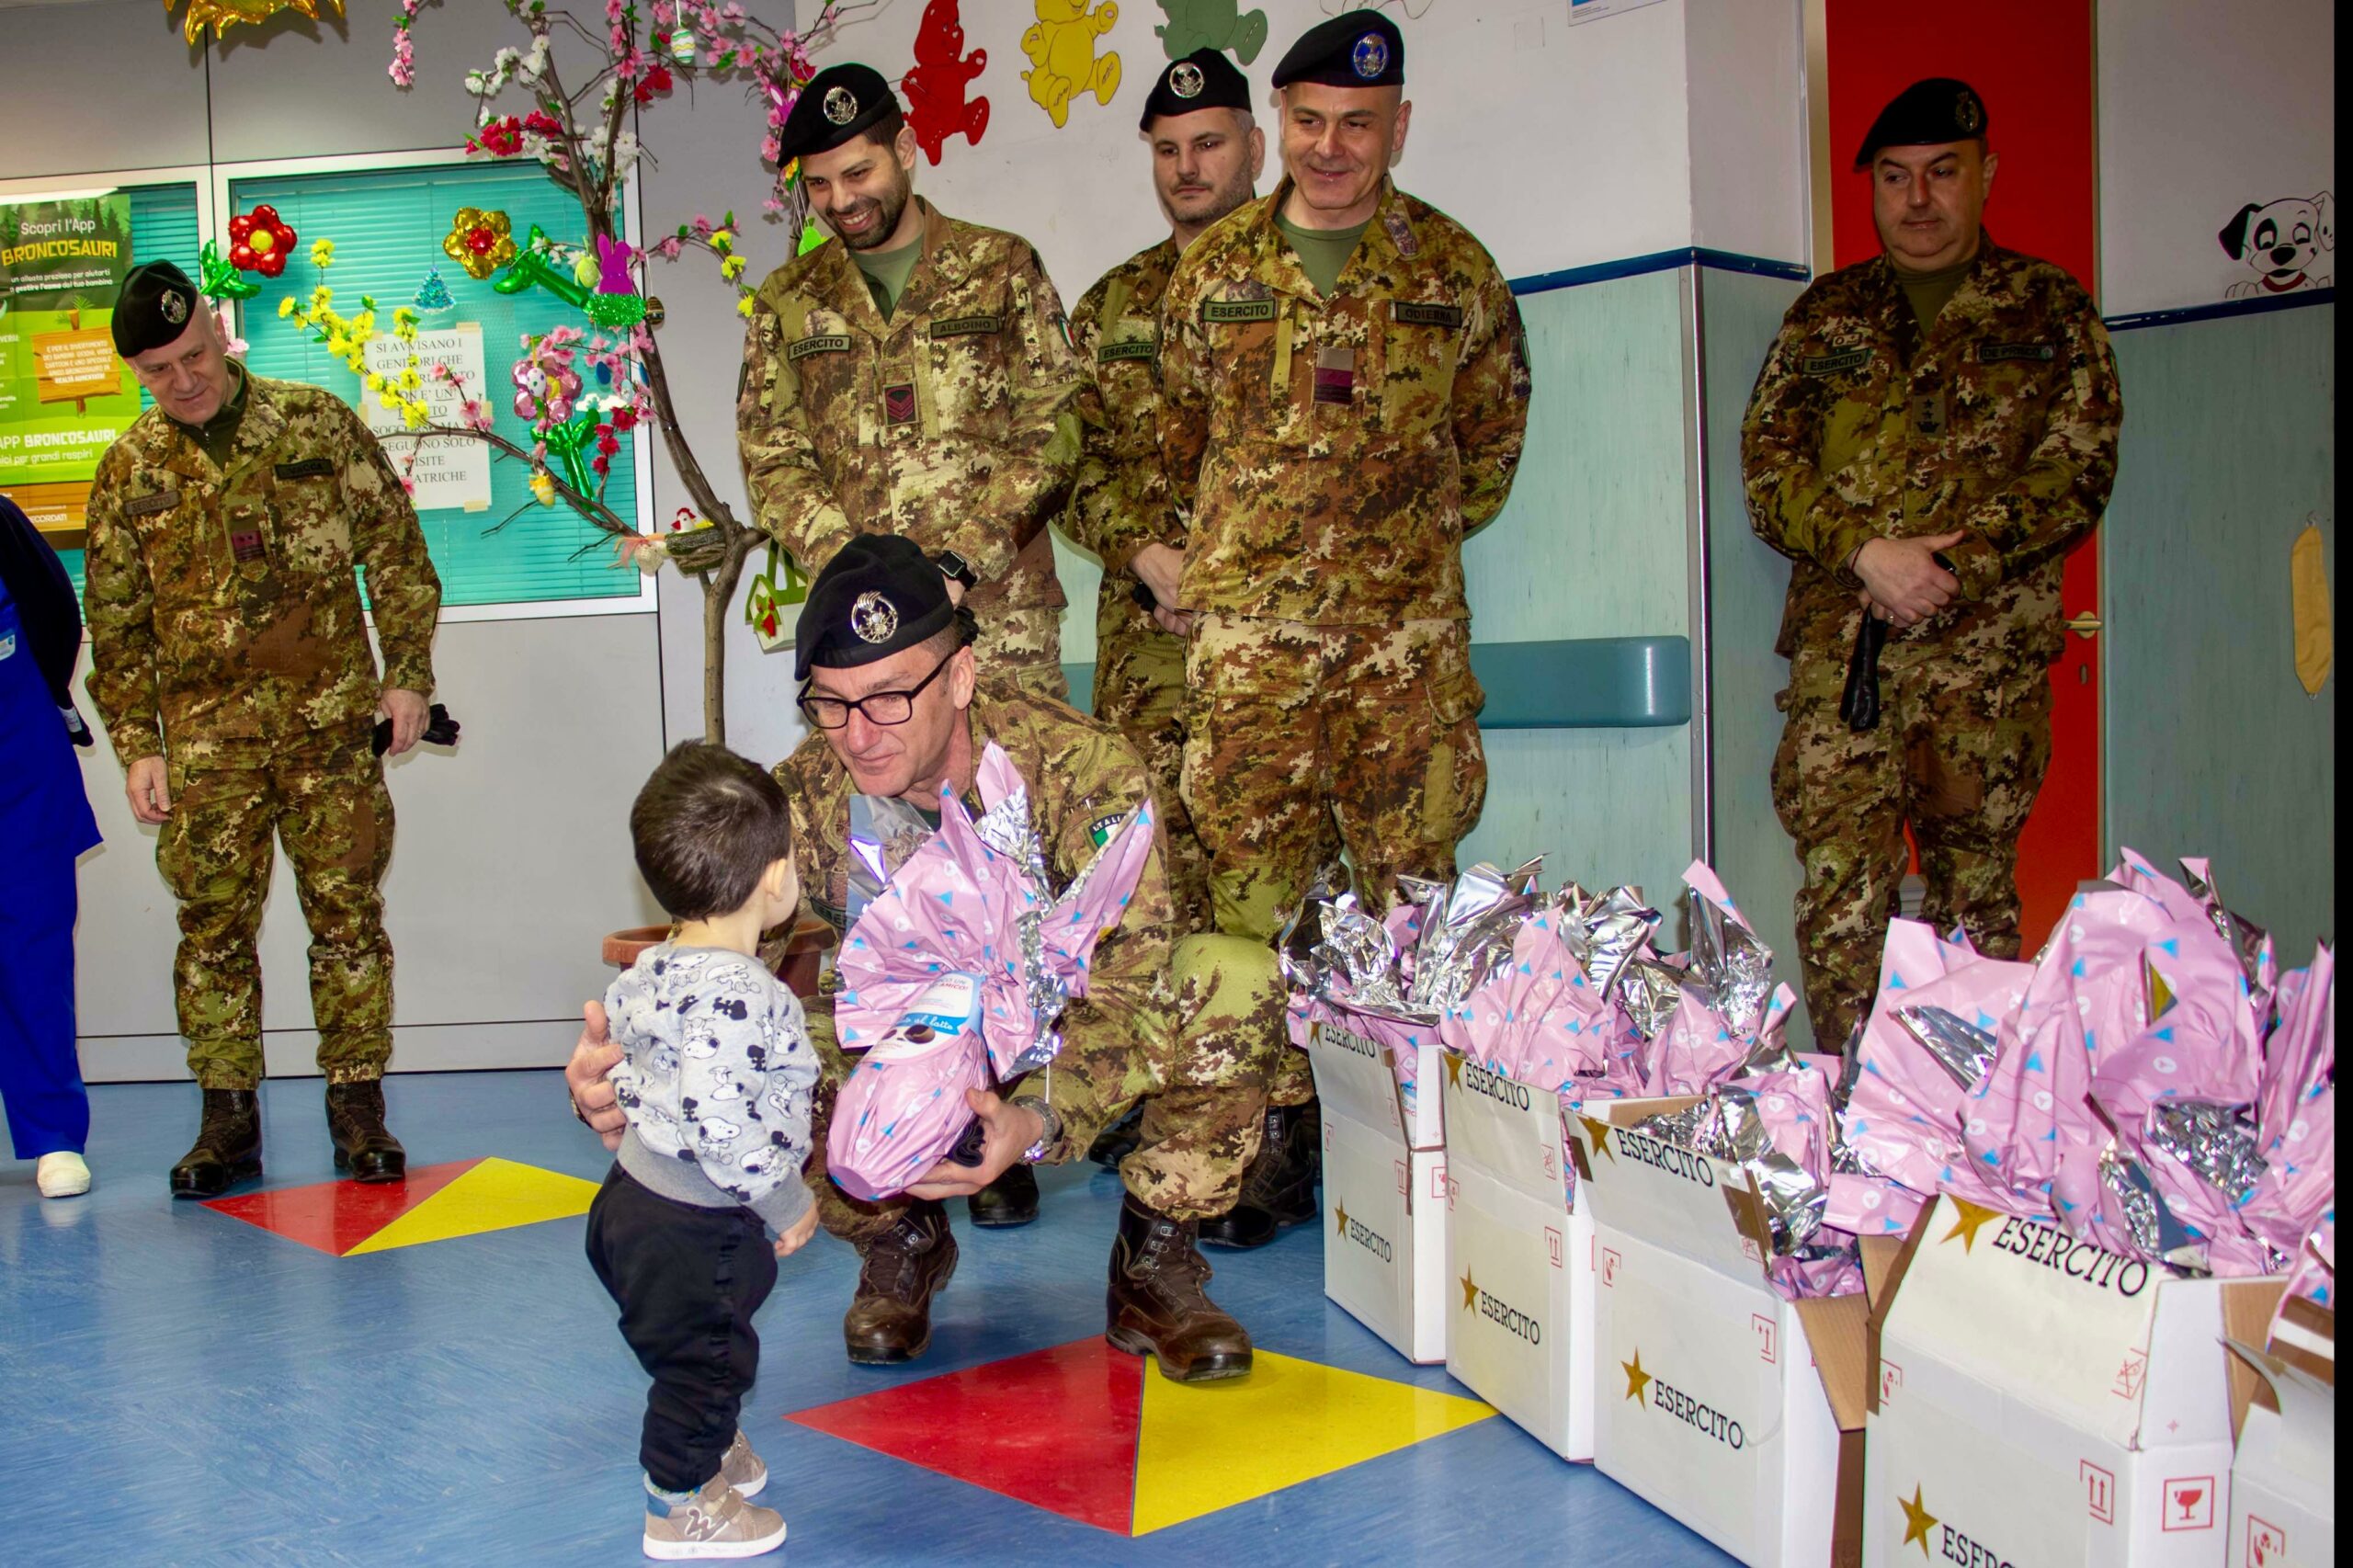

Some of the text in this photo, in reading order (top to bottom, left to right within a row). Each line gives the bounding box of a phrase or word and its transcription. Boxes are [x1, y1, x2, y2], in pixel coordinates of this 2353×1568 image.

[20, 218, 96, 236] Scopri l'App
[1, 240, 118, 267] BRONCOSAURI
[1211, 304, 1268, 318] ESERCITO
[940, 321, 991, 333] ALBOINO
[376, 343, 386, 354] SI
[390, 338, 455, 352] AVVISANO
[792, 338, 844, 356] ESERCITO
[1104, 345, 1153, 358] ESERCITO
[1810, 354, 1861, 369] ESERCITO
[24, 428, 116, 448] BRONCOSAURI
[443, 437, 476, 449] SOLO
[14, 455, 28, 466] per
[31, 450, 60, 465] grandi
[62, 448, 93, 461] respiri
[1092, 814, 1126, 832] ITALI
[929, 1016, 953, 1030] latte
[1325, 1026, 1375, 1058] ESERCITO
[1465, 1062, 1530, 1111] ESERCITO
[1614, 1128, 1714, 1187] ESERCITO
[1350, 1219, 1392, 1264] ESERCITO
[1992, 1214, 2149, 1297] ESERCITO
[1482, 1290, 1540, 1346] ESERCITO
[1654, 1380, 1744, 1449] ESERCITO
